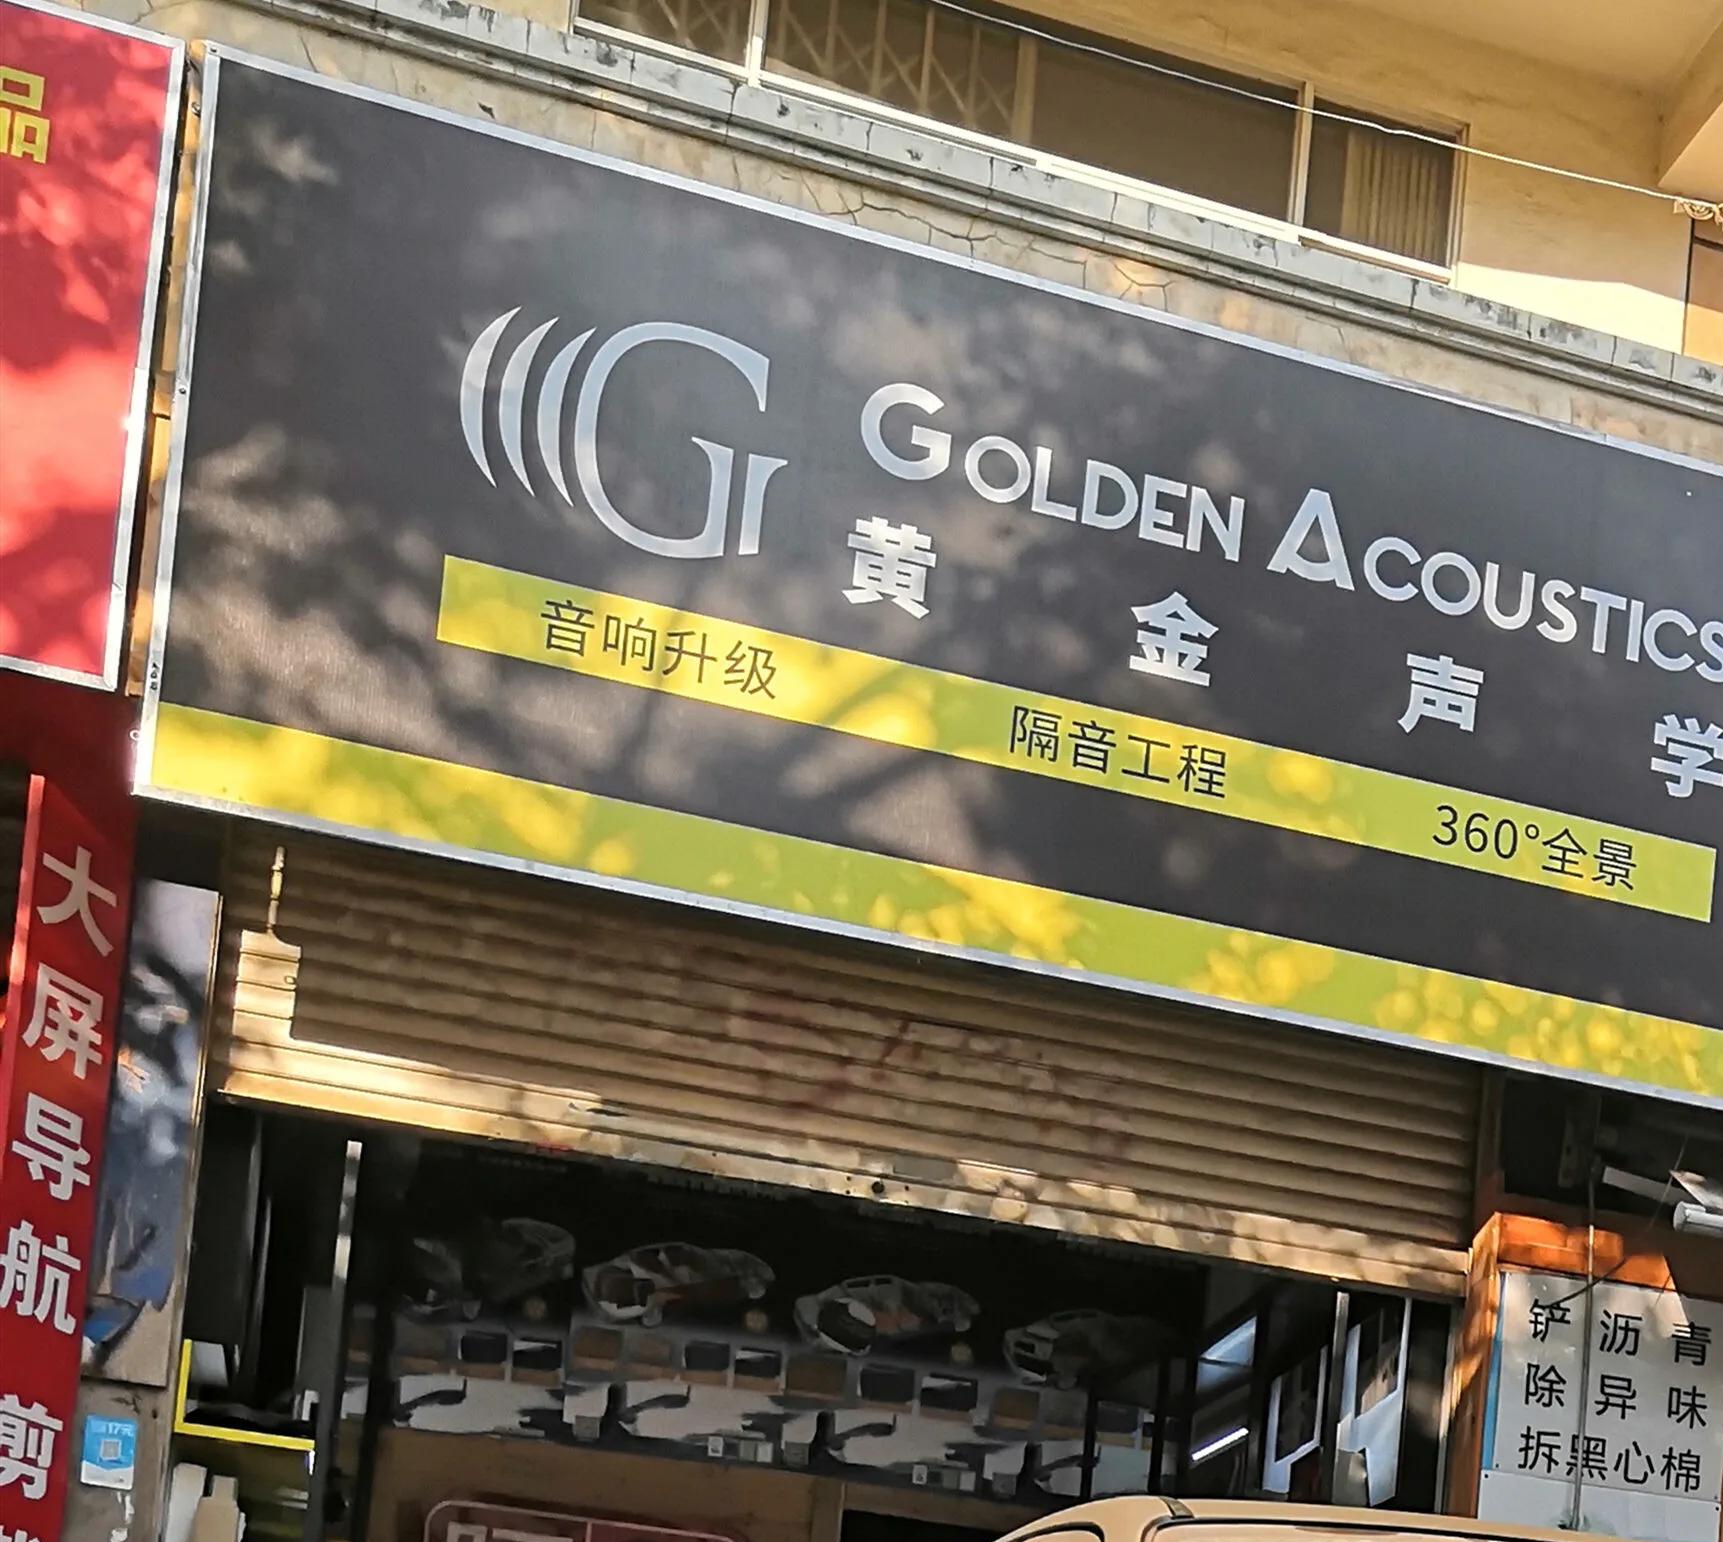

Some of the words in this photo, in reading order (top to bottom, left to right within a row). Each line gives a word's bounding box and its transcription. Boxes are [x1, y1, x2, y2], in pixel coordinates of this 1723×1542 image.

[859, 382, 1245, 563] GOLDEN
[540, 598, 778, 701] 音响升级
[1008, 704, 1228, 799] 隔音工程
[1431, 804, 1638, 892] 360°全景
[0, 843, 117, 1335] 大屏导航
[1517, 1425, 1701, 1494] 拆黑心棉
[1524, 1362, 1708, 1429] 除异味
